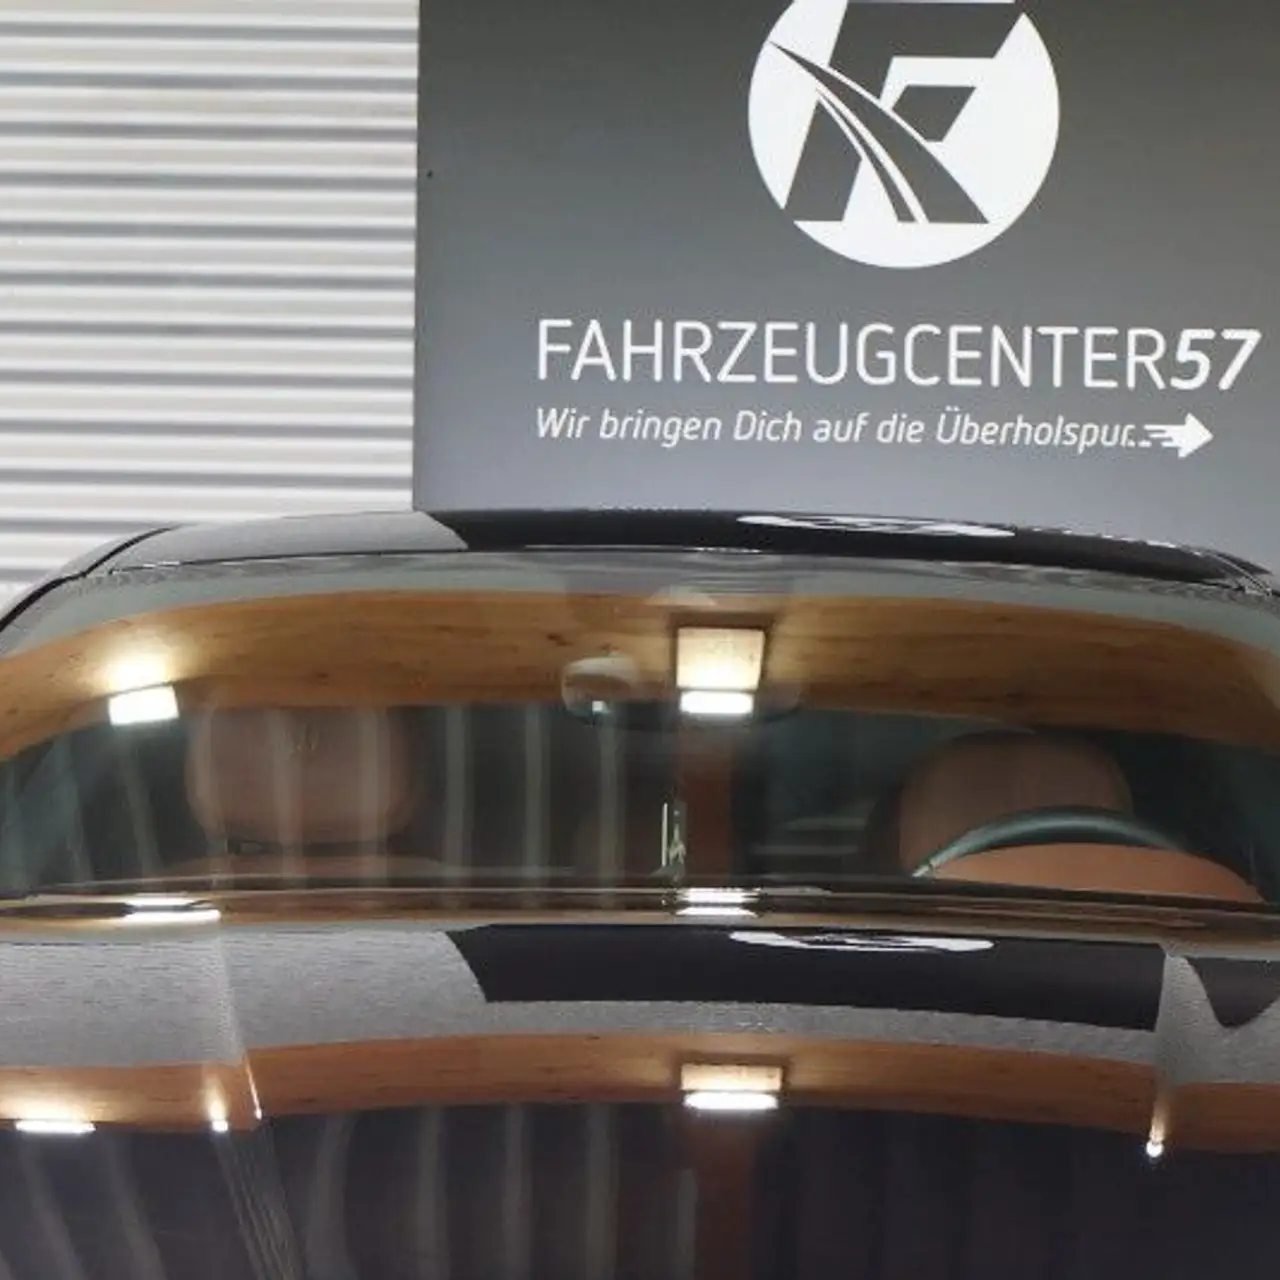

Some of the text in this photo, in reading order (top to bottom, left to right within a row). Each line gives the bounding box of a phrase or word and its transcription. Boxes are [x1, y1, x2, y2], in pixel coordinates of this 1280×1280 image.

[537, 319, 1261, 390] FAHRZEUGCENTER57
[536, 407, 590, 438] Wir
[599, 408, 722, 448] bringen
[733, 410, 802, 442] Dich
[813, 411, 870, 444] auf
[876, 413, 925, 443] die
